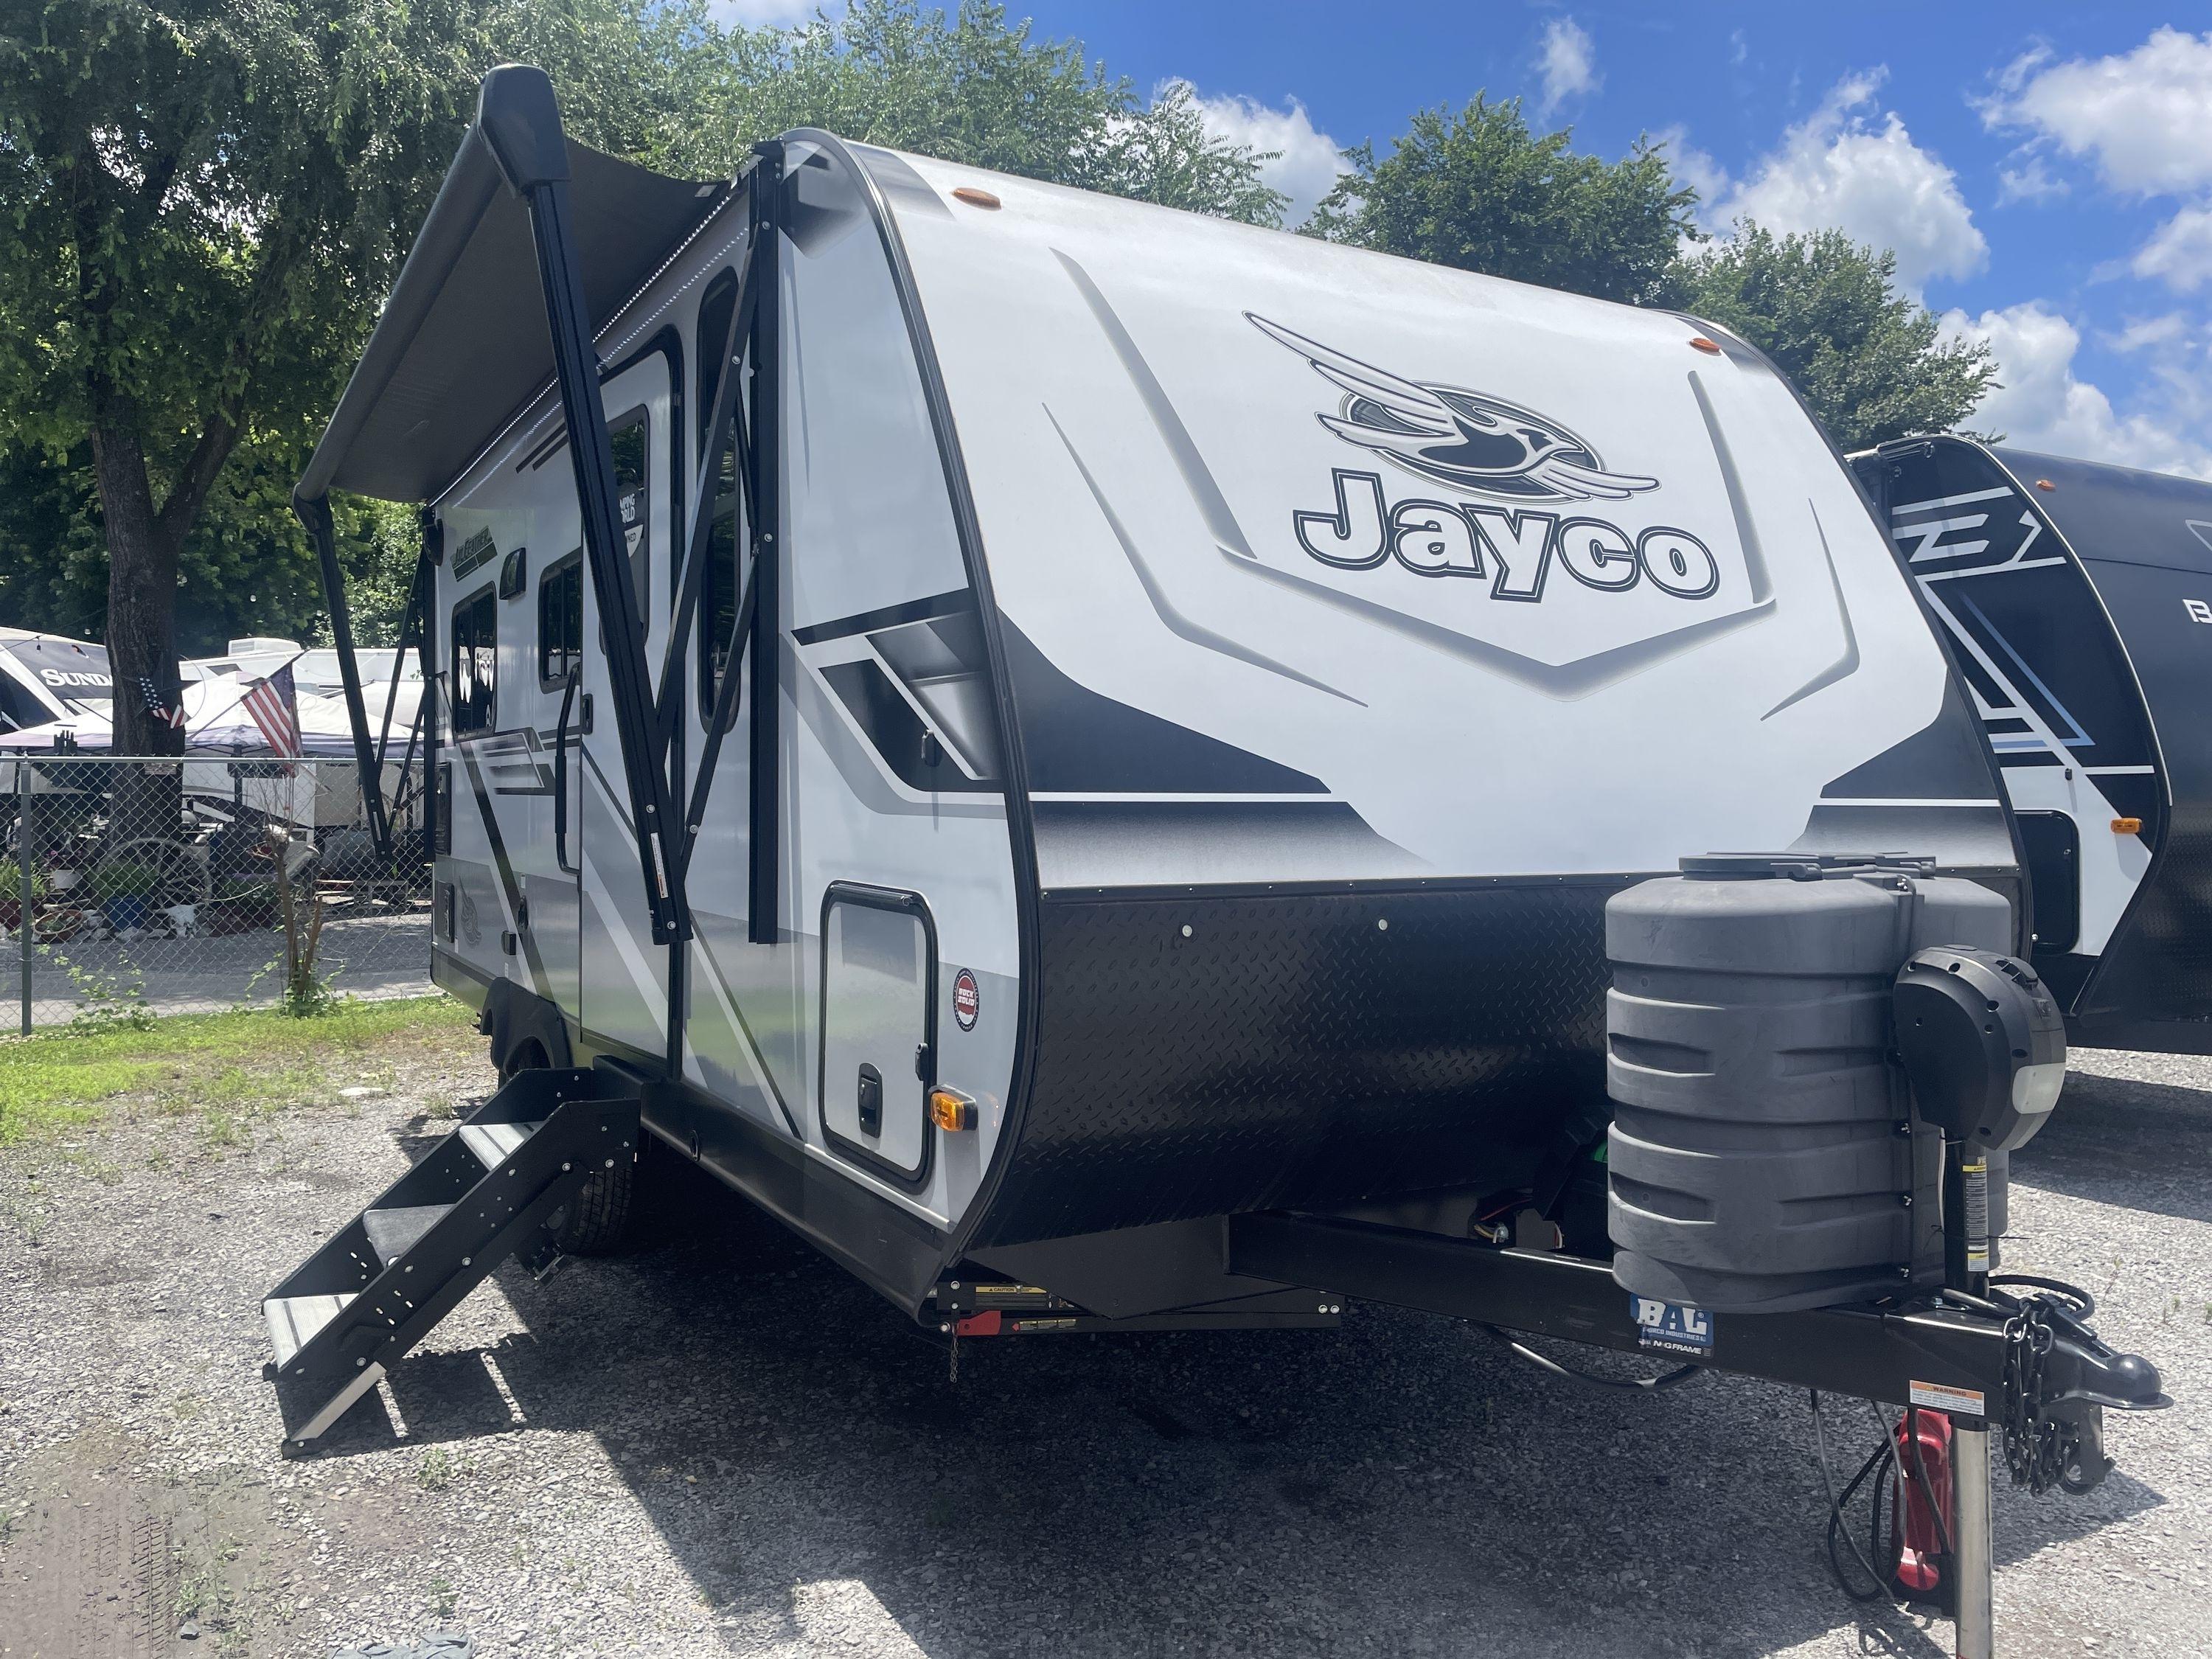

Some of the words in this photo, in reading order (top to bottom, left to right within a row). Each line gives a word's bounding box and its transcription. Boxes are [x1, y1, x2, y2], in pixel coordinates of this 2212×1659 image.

[1293, 467, 1719, 602] Jayco
[958, 987, 974, 998] ROCK
[957, 995, 975, 1006] SOLID
[1665, 1329, 1700, 1340] INDUSTRIES
[1672, 1343, 1703, 1354] FRAME
[1932, 1386, 1967, 1397] WARNING
